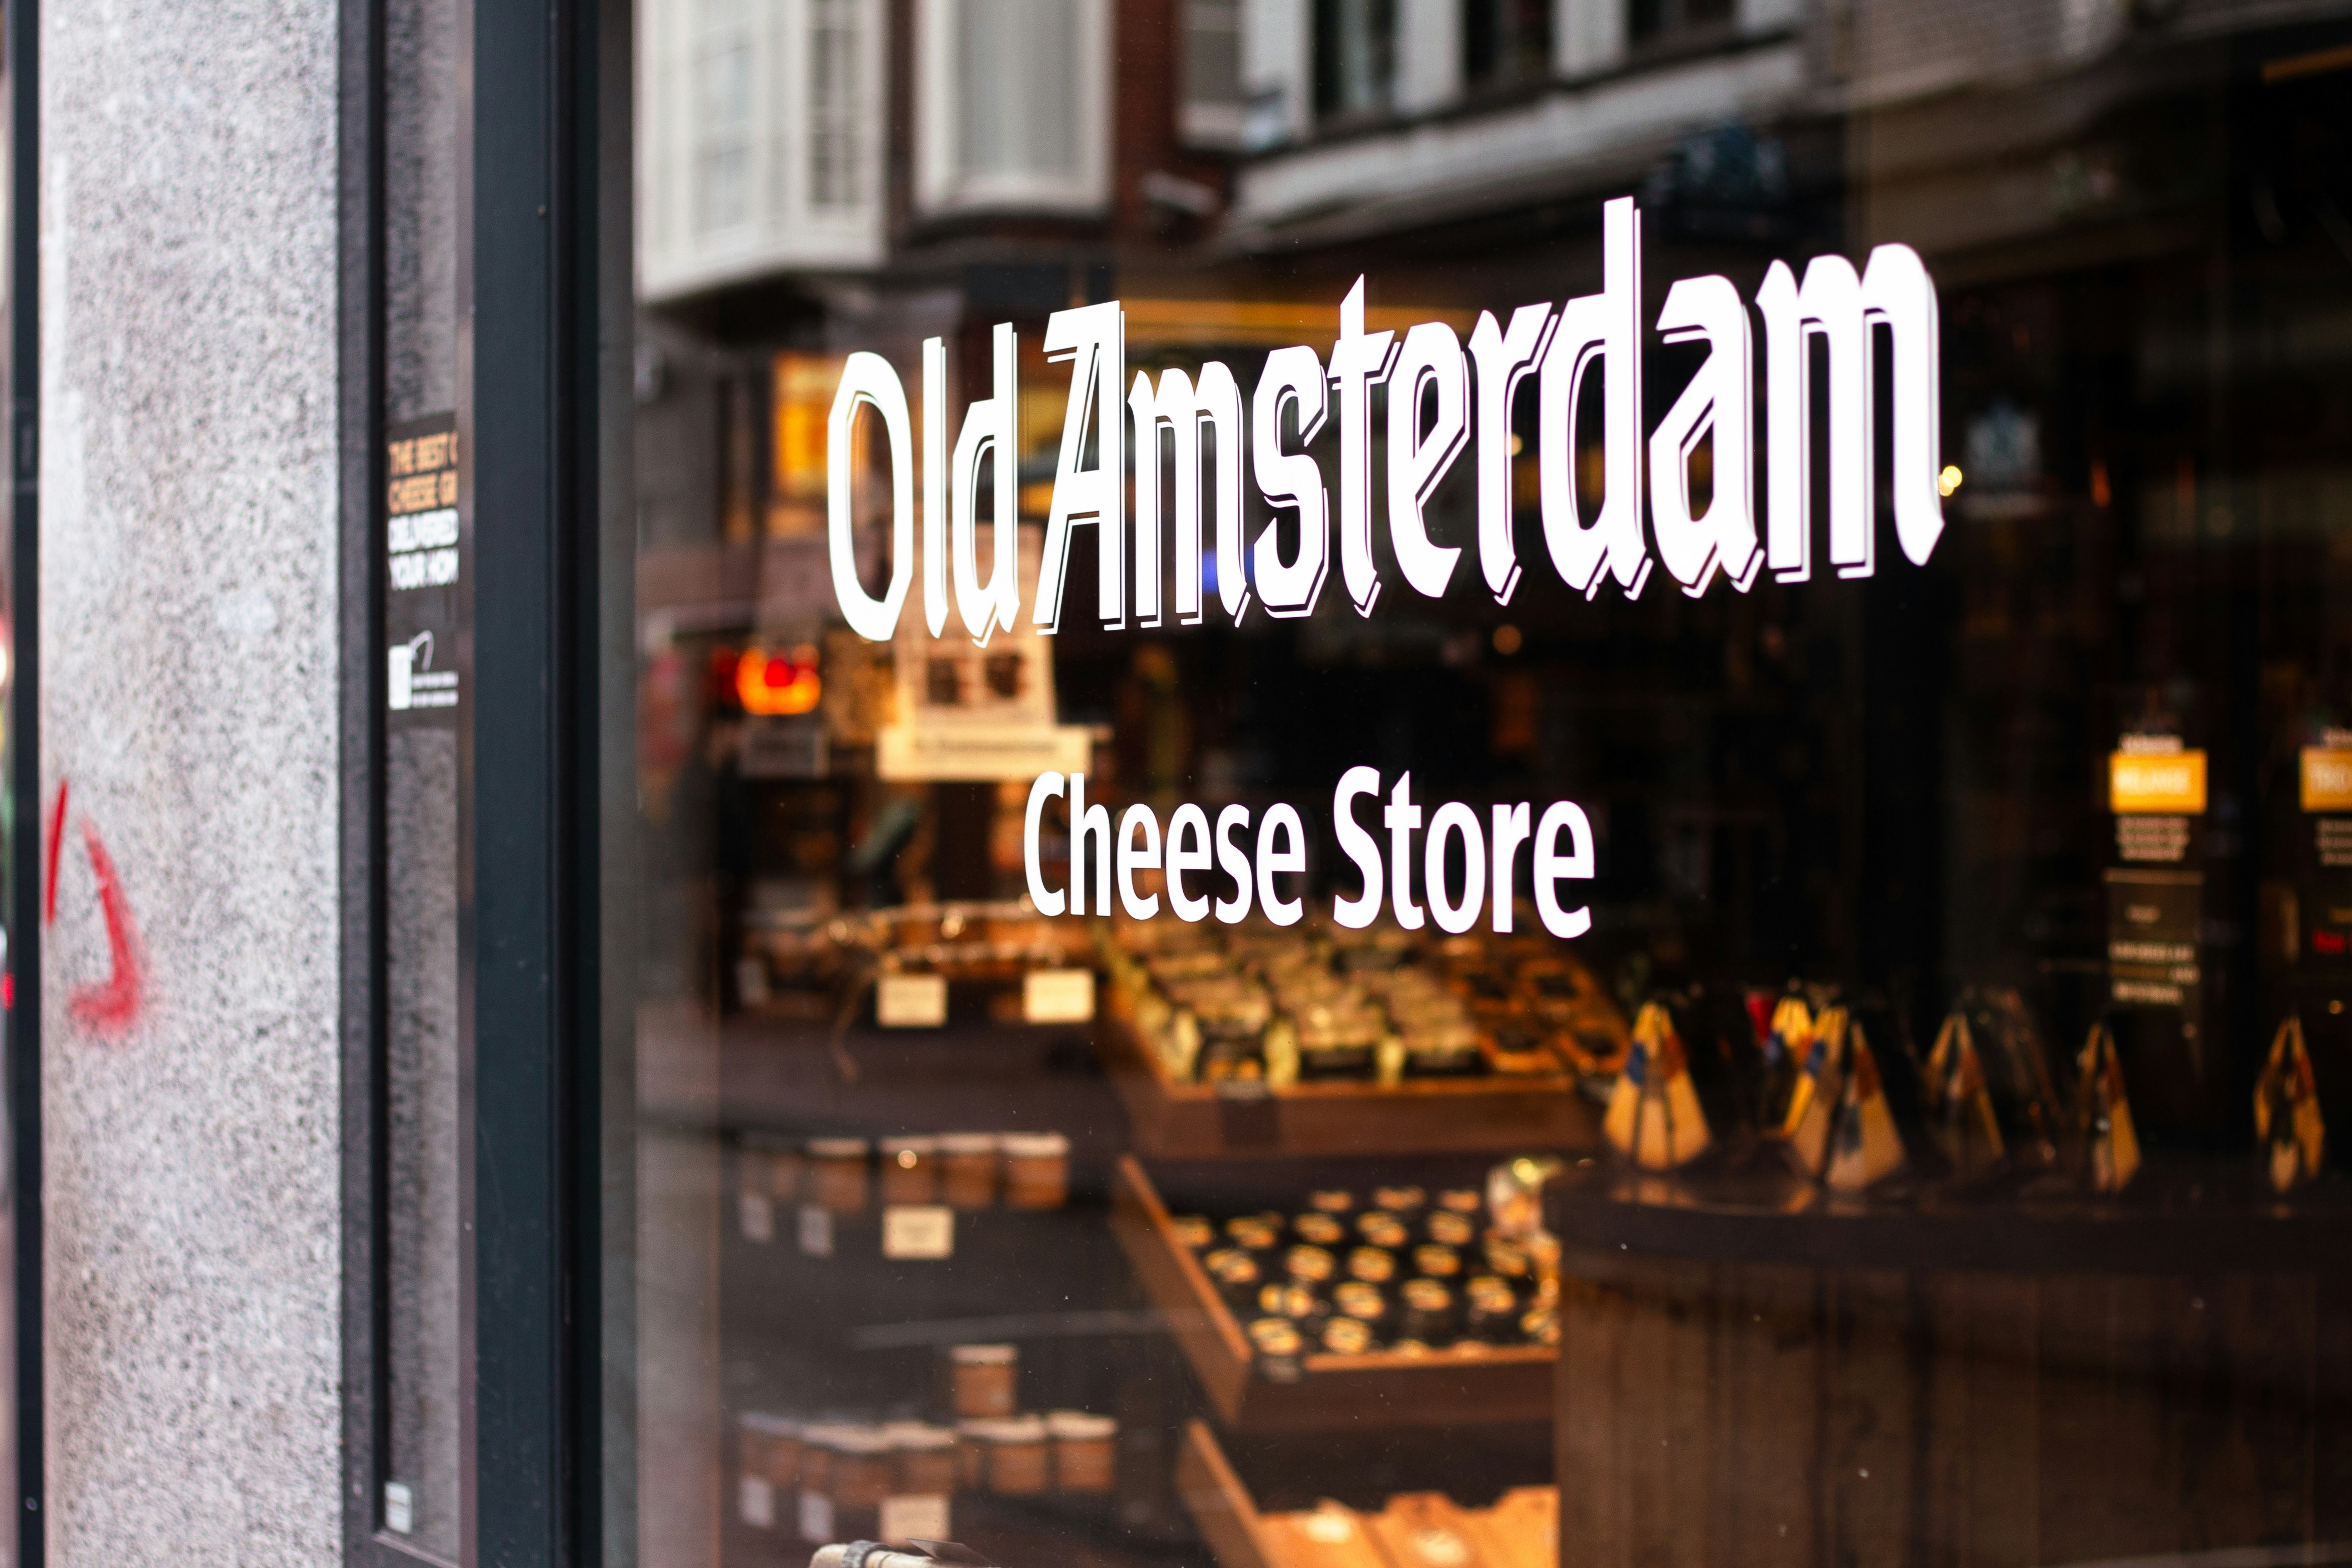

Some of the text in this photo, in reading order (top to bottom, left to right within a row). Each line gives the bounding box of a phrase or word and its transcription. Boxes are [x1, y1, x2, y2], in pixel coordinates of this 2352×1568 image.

[828, 196, 1944, 649] Old Amsterdam
[388, 438, 414, 475] THE
[417, 432, 448, 472] BEST
[388, 473, 437, 515] CHEESE
[388, 553, 424, 590] YOUR
[1024, 765, 1595, 939] Cheese Store
